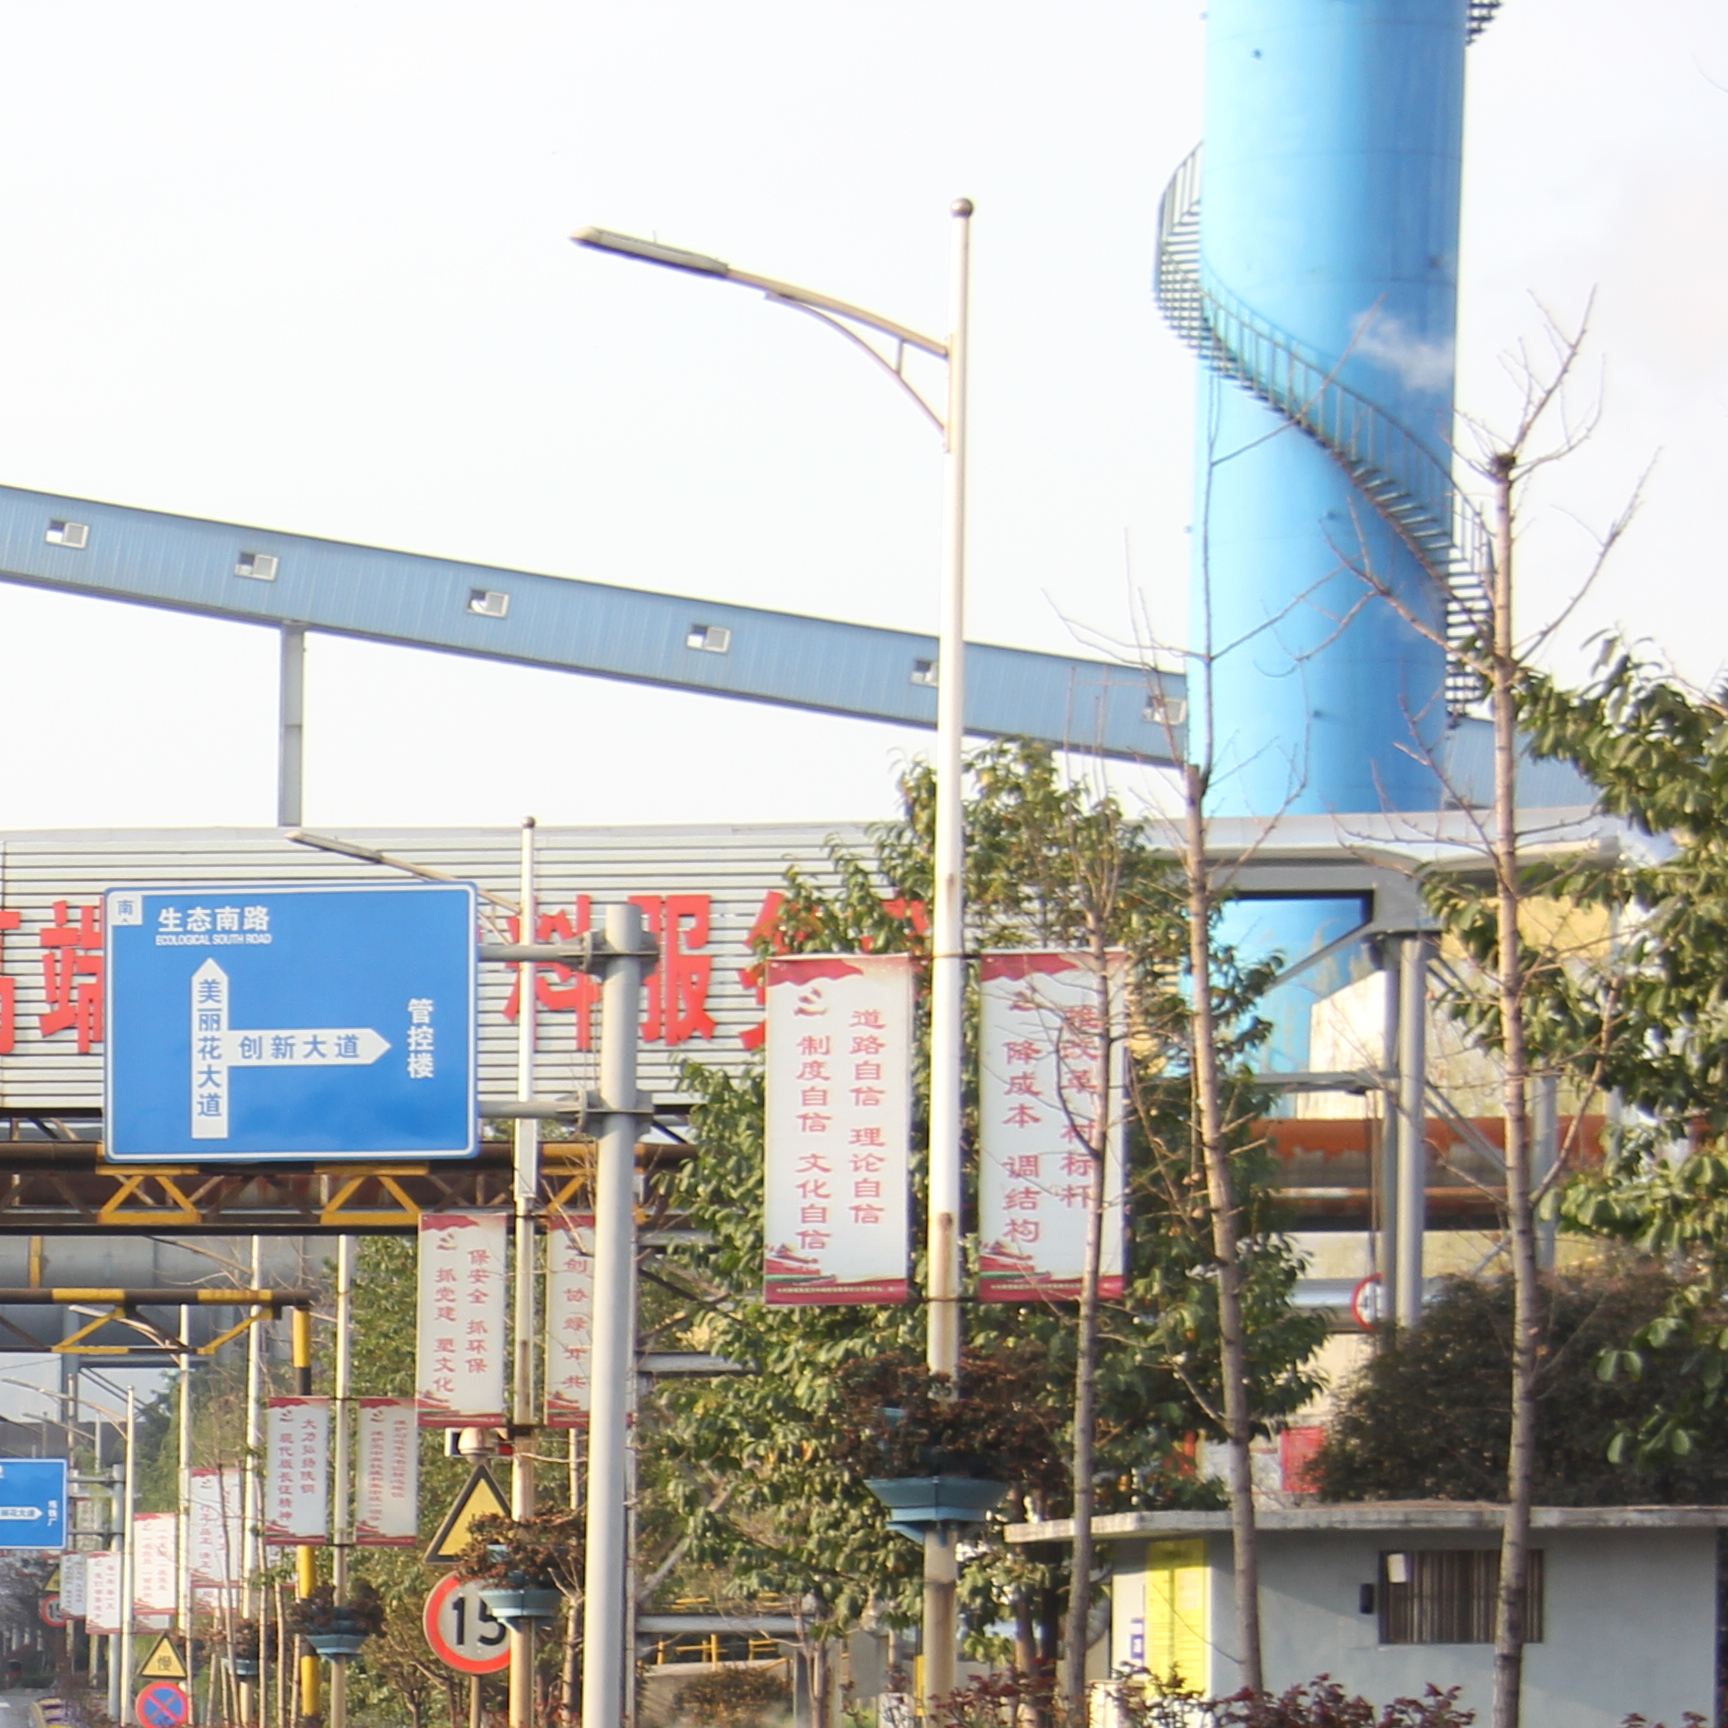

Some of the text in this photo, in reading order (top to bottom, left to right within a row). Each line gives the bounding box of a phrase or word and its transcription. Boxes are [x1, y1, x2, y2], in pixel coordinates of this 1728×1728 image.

[118, 899, 134, 916] 南
[155, 933, 272, 946] ECOLOGICAL SOUTH ROAD
[157, 905, 270, 932] 生态南路
[197, 978, 222, 1117] 美丽花大道
[239, 1034, 360, 1060] 创新大道
[406, 998, 434, 1079] 管控楼
[795, 1036, 833, 1250] 制度自信 文化自信
[848, 1009, 887, 1224] 道路自信 理论自信
[1003, 1040, 1042, 1244] 降成本 调结构
[435, 1267, 458, 1323] 抓党建
[465, 1249, 491, 1374] 保安全 抓环保
